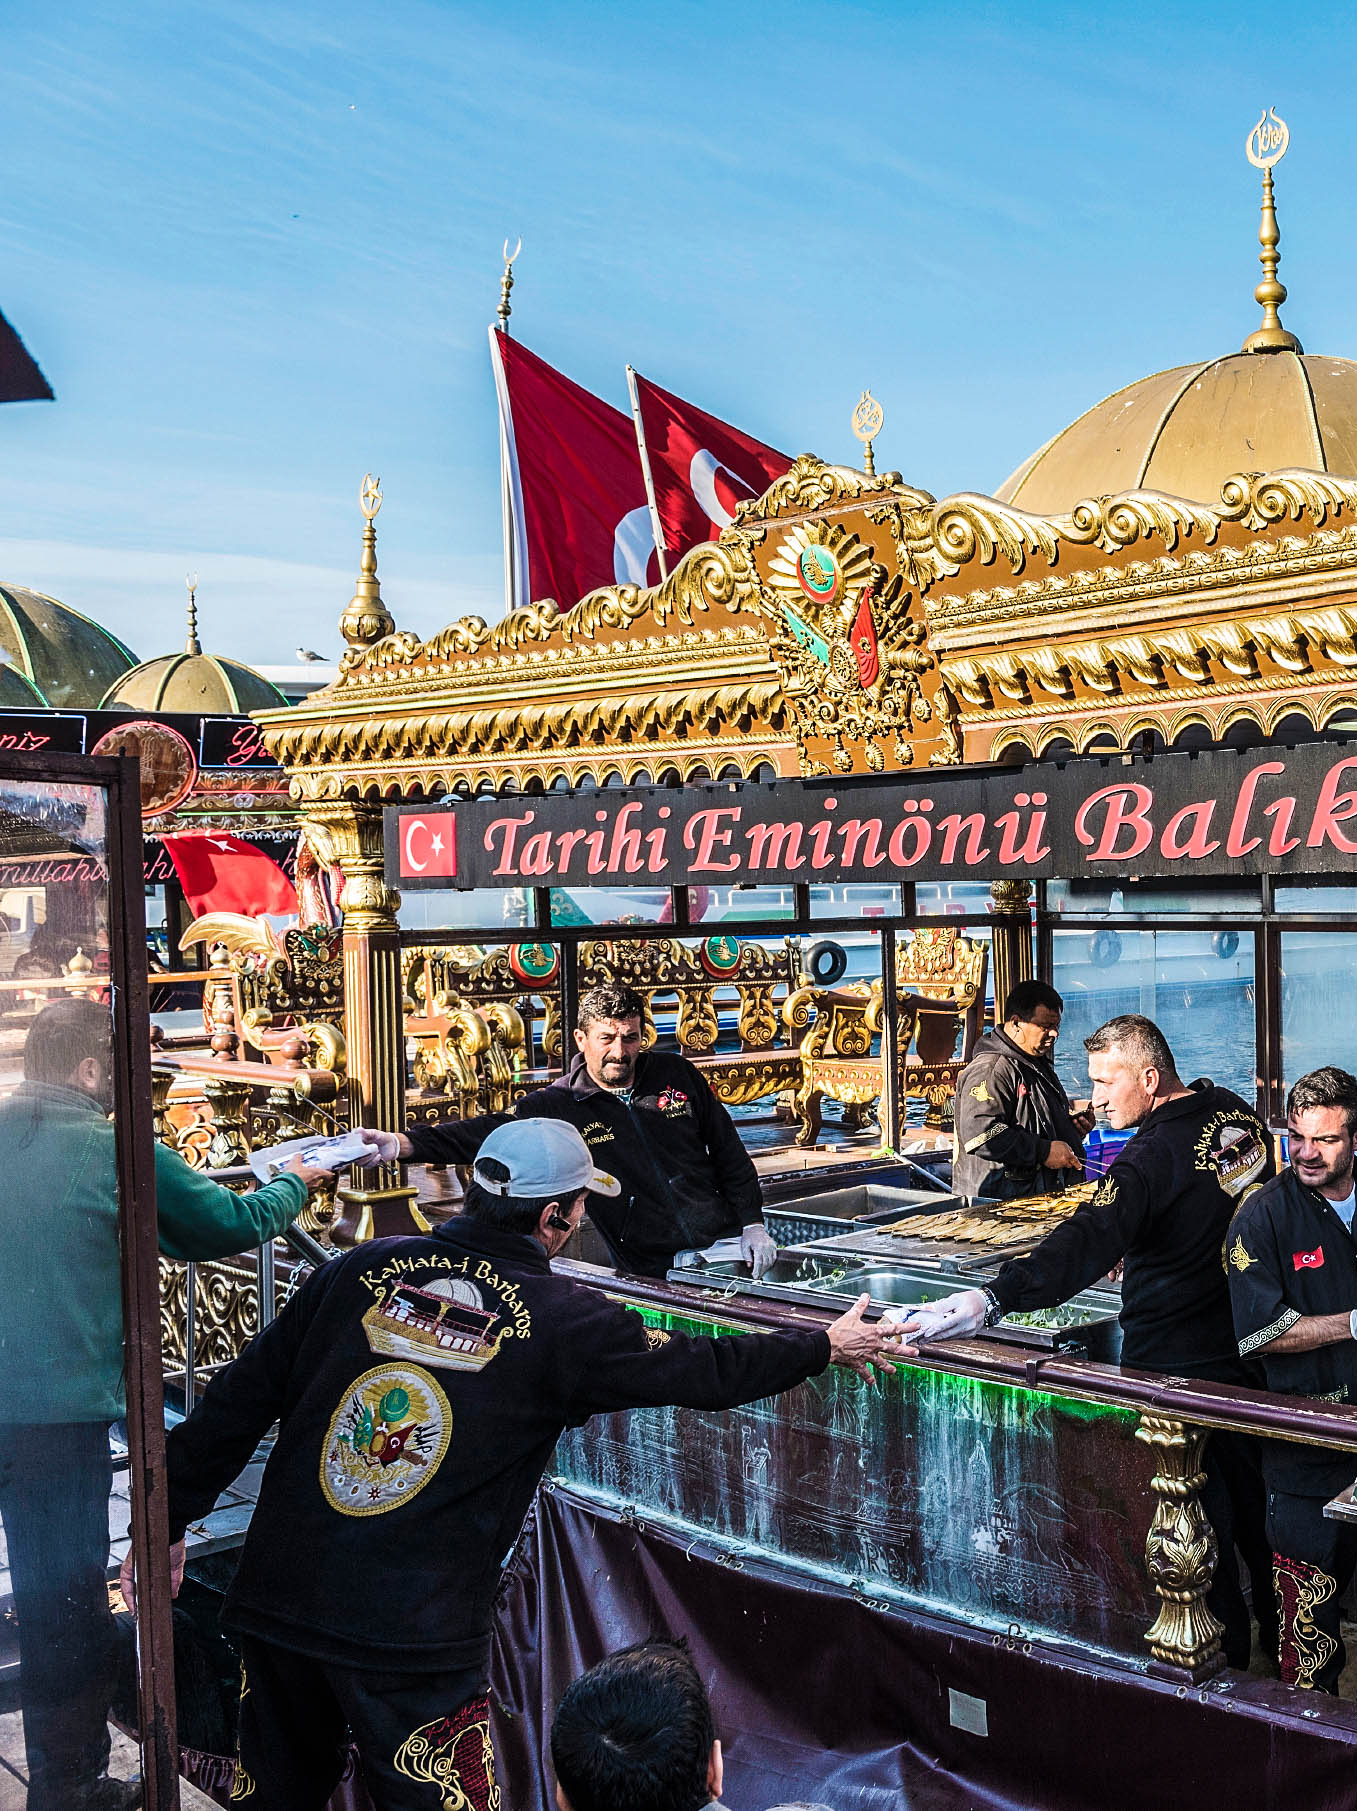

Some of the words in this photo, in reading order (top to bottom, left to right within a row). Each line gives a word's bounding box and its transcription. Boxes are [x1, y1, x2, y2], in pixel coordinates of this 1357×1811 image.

[483, 801, 669, 876] Tarihi
[682, 792, 1050, 872] Eminönü
[474, 1260, 531, 1339] Barbaros
